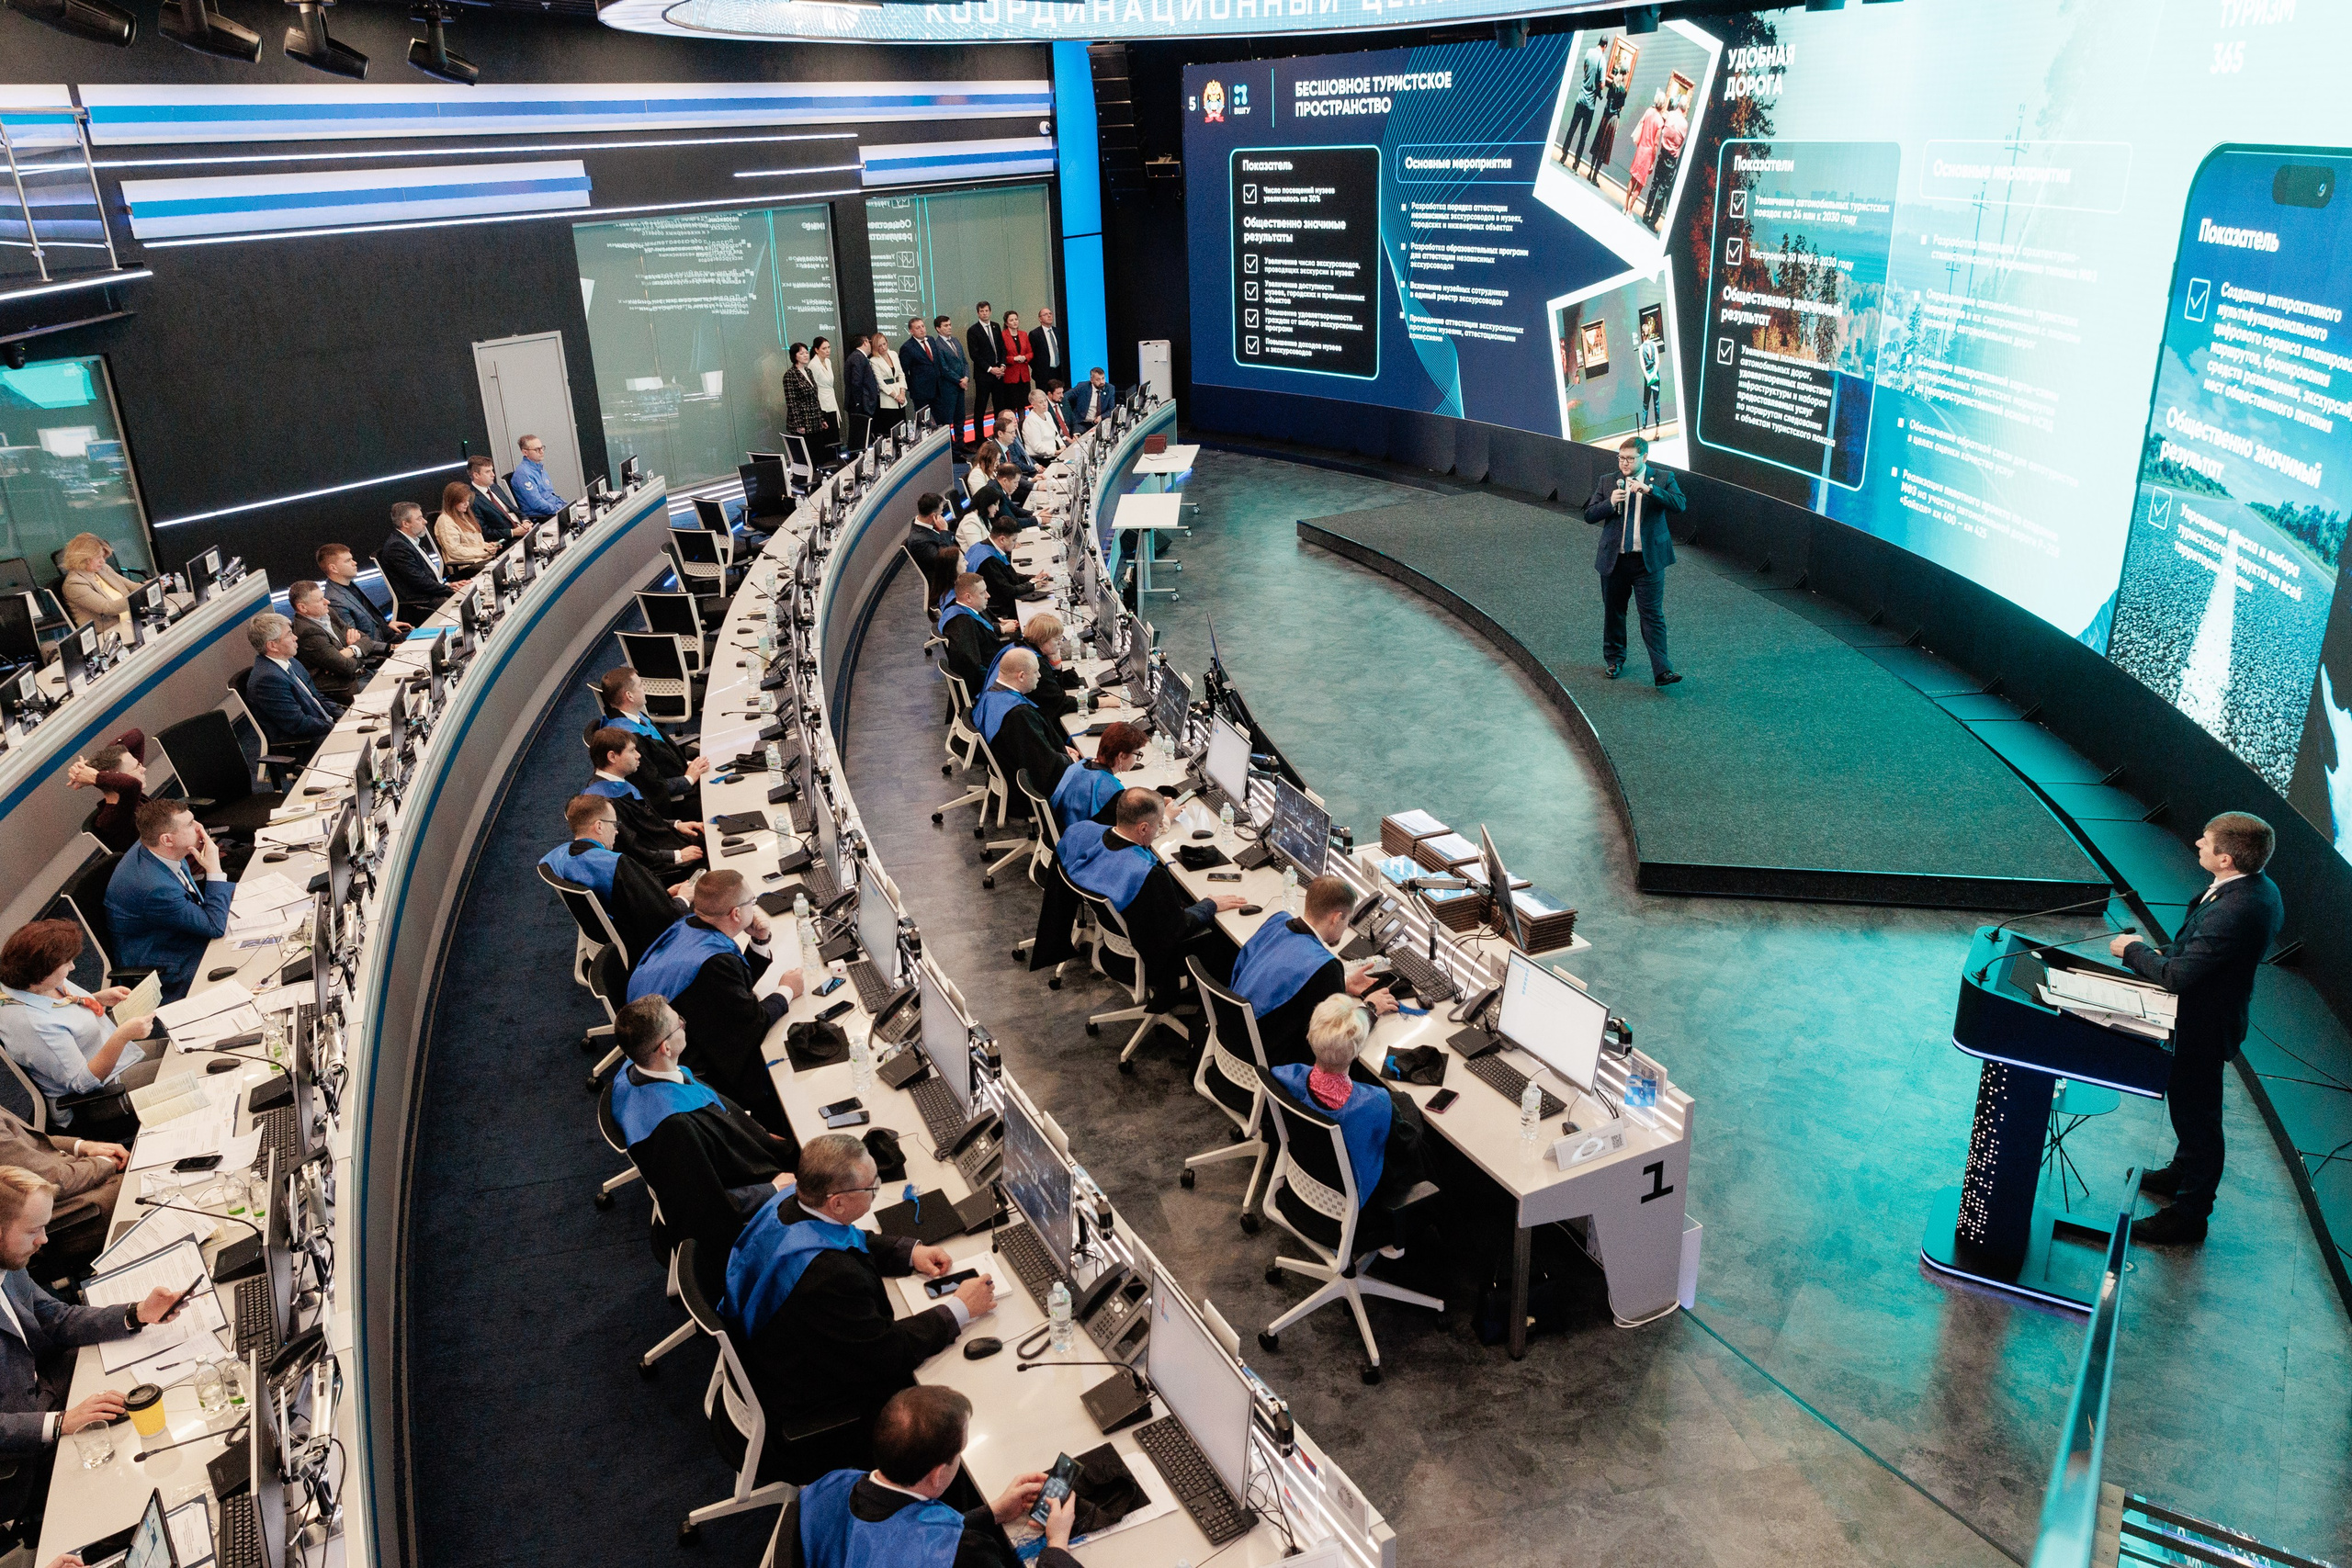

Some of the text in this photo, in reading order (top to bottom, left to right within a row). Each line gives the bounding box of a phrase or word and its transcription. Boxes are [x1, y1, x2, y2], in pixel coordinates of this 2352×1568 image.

[2220, 0, 2297, 28] ТУРИЗМ
[1728, 43, 1795, 73] УДОБНАЯ
[2210, 40, 2245, 73] 365
[1295, 72, 1452, 96] БЕСШОВНОЕ ТУРИСТСКОЕ
[1724, 74, 1783, 100] ДОРОГА
[1189, 96, 1195, 111] 5
[1295, 96, 1391, 117] ПРОСТРАНСТВО
[1243, 159, 1293, 172] Показатель
[1405, 156, 1512, 172] Основные мероприятия
[1733, 155, 1794, 173] Показатели
[1933, 159, 2071, 186] Основные мероприятия
[1411, 201, 1446, 211] Разработка
[1755, 195, 1794, 207] Увеличение
[1243, 216, 1346, 230] Общественно значимые
[1781, 211, 1792, 220] на
[1822, 211, 1840, 222] 2030
[1841, 215, 1857, 226] году
[1243, 232, 1293, 243] результаты
[2198, 218, 2279, 253] Показатель
[1750, 249, 1786, 262] Построено
[1787, 253, 1796, 263] 30
[1819, 256, 1837, 267] 2030
[1838, 259, 1854, 272] году
[1723, 286, 1843, 318] Общественно значимый
[2221, 281, 2342, 323] Создание интерактивного
[1721, 309, 1771, 326] результат
[2216, 304, 2328, 342] мультифункционального
[2213, 322, 2301, 356] цифрового сервиса
[1791, 368, 1813, 381] дорог,
[2210, 341, 2331, 388] маршрутов, бронирования
[1738, 380, 1792, 400] инфраструктуры
[2207, 360, 2243, 380] средств
[2243, 371, 2301, 402] размещения,
[1736, 402, 1745, 411] по
[1794, 405, 1814, 418] услуг
[2225, 384, 2294, 418] общественного
[2294, 409, 2333, 434] питания
[1812, 434, 1836, 447] показа
[1909, 419, 1956, 443] Обеспечение
[2166, 405, 2323, 489] Общественно значимый
[2159, 441, 2224, 479] результат
[1903, 468, 1943, 492] Реализация
[1942, 511, 1957, 525] 400
[2180, 502, 2228, 538] Упрощение
[2177, 524, 2226, 557] туристского
[2280, 579, 2301, 602] всей
[1640, 1160, 1674, 1204] 1
